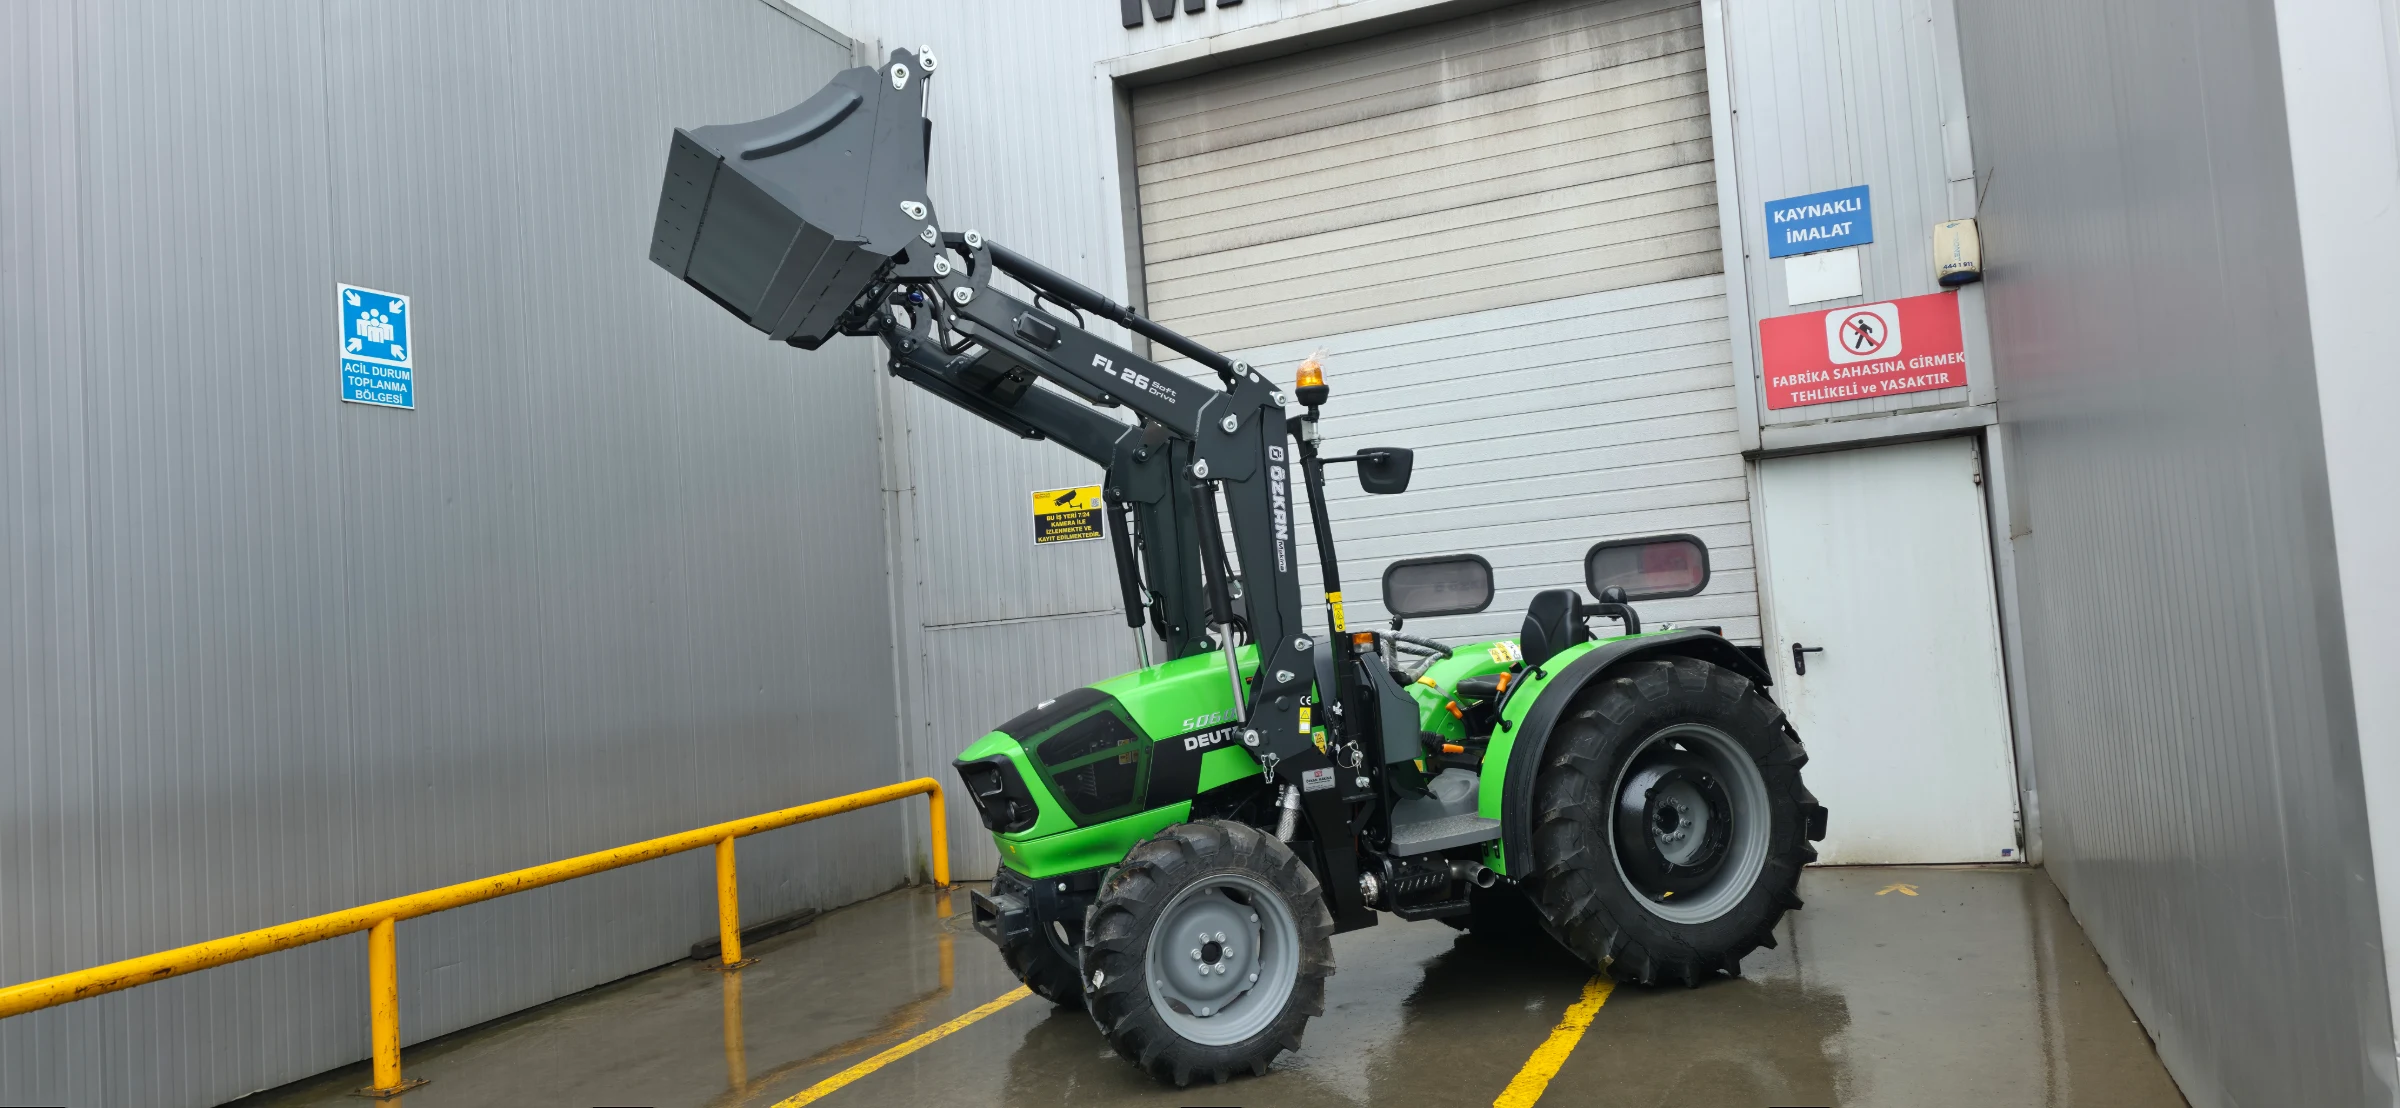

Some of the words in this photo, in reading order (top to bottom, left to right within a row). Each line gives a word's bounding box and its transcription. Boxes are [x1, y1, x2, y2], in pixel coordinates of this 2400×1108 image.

[1773, 197, 1862, 224] KAYNAKLI
[1786, 221, 1853, 245] İMALAT
[1943, 262, 1957, 270] 444
[344, 362, 370, 375] ACİL
[372, 366, 410, 380] DURUM
[1091, 353, 1117, 376] FL
[1120, 367, 1150, 390] 26
[1772, 368, 1830, 388] FABRİKA
[1833, 359, 1906, 380] SAHASINA
[1909, 351, 1965, 370] GİRMEK
[347, 376, 408, 392] TOPLANMA
[1151, 380, 1177, 397] Soft
[1790, 381, 1858, 403] TEHLİKELİ
[1861, 382, 1877, 395] ve
[1880, 372, 1950, 392] YASAKTIR
[355, 390, 403, 405] BÖLGESİ
[1148, 387, 1176, 404] Drive
[1270, 465, 1288, 541] ÖZKAN
